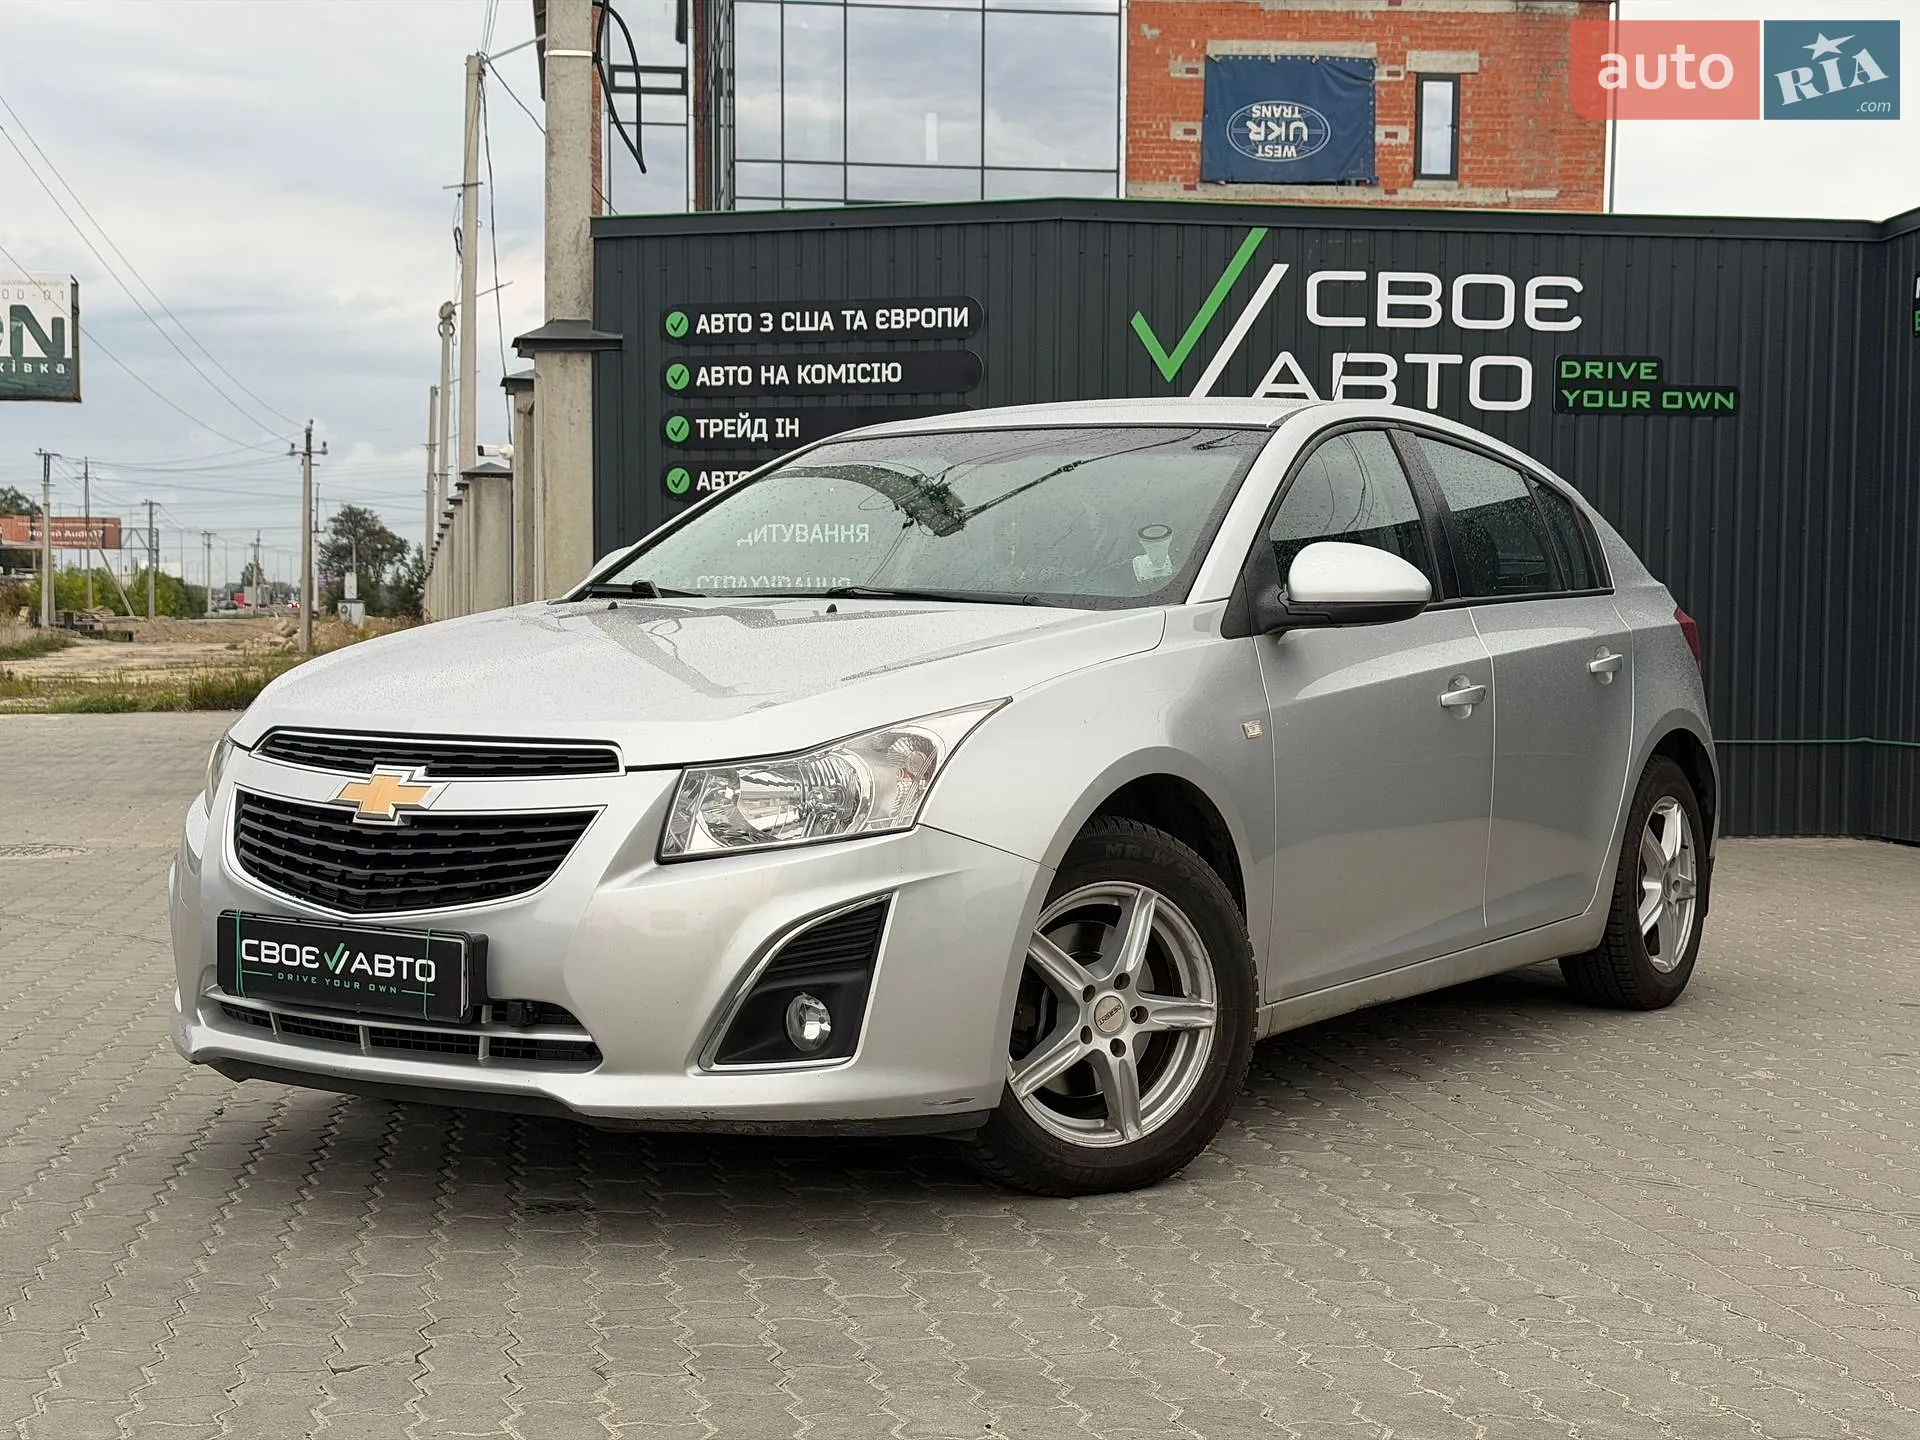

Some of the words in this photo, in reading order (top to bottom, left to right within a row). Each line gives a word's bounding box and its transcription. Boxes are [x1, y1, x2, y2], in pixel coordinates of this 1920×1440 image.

[1252, 104, 1302, 119] TRANS
[1246, 120, 1309, 142] UKR
[1255, 144, 1297, 158] WEST
[1306, 271, 1584, 332] СВОЄ
[0, 304, 66, 358] N
[696, 312, 753, 335] АВТО
[759, 312, 774, 333] З
[781, 310, 835, 332] США
[841, 308, 869, 331] ТА
[875, 306, 970, 330] ЄВРОПИ
[696, 365, 753, 387] АВТО
[760, 364, 790, 386] НА
[797, 362, 903, 385] КОМІСІЮ
[1250, 350, 1533, 411] АВТО
[1560, 360, 1659, 380] DRIVE
[1561, 389, 1651, 409] YOUR
[1662, 391, 1735, 410] OWN
[695, 412, 769, 443] ТРЕЙД
[775, 417, 801, 438] ІН
[241, 939, 321, 969] СВОЄ
[350, 951, 437, 984] АВТО
[277, 973, 318, 985] DRIVE
[324, 978, 362, 990] YOUR
[368, 984, 398, 995] OWN
